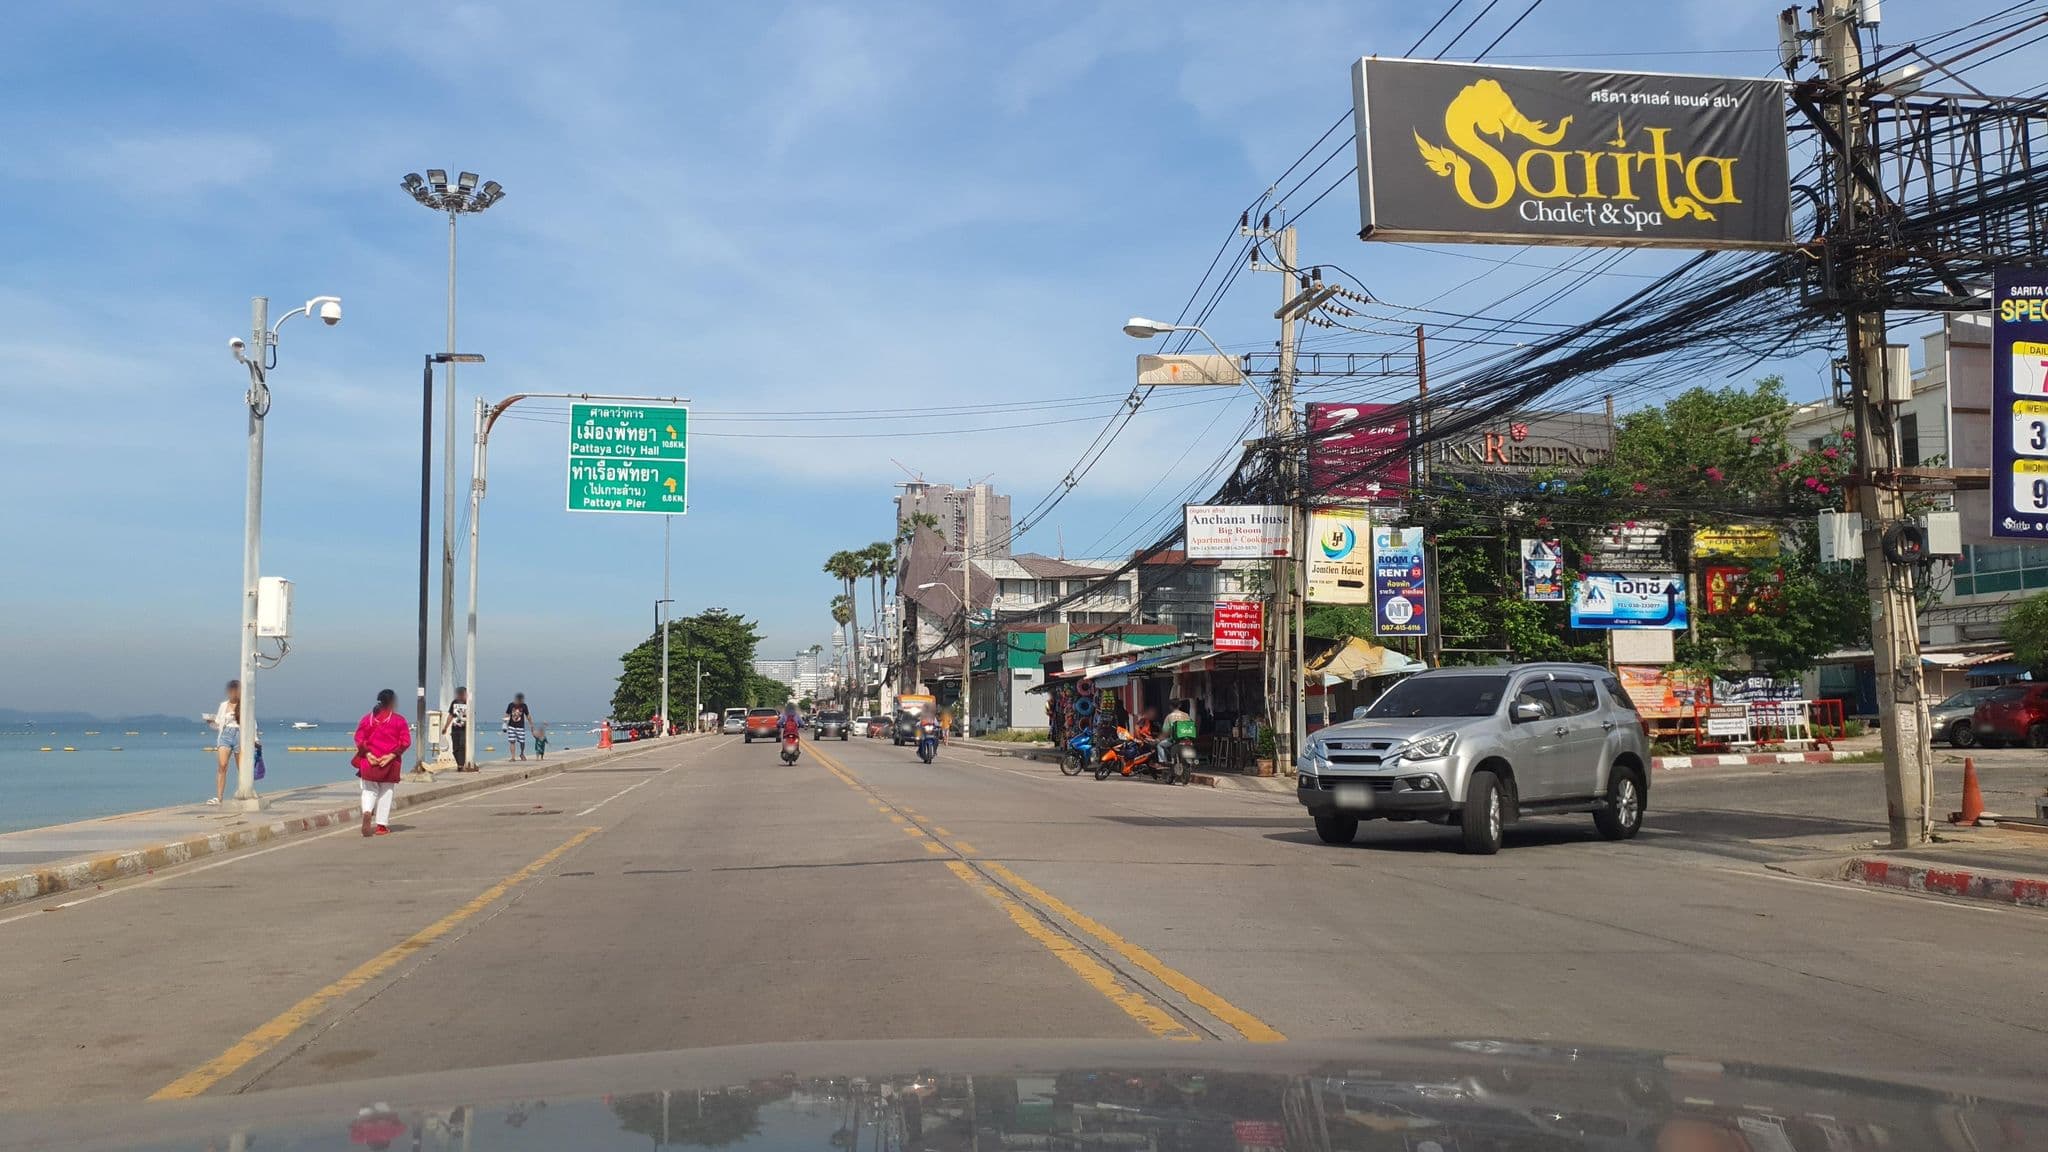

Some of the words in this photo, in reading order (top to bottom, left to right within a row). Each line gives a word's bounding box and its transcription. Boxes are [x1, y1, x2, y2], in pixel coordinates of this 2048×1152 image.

[1591, 89, 1627, 103] ศริตา
[1630, 91, 1670, 105] ชาเลต์
[1674, 93, 1709, 107] แอนด์
[1713, 94, 1739, 108] สปา
[1413, 79, 1742, 221] Sarita
[1520, 200, 1597, 227] Chalet
[1600, 204, 1621, 223] &
[1624, 204, 1663, 231] Spa
[2010, 286, 2043, 296] SARITA
[590, 407, 644, 419] ศาลาว่าการ
[577, 420, 657, 442] เมืองพัทยา
[2031, 420, 2046, 450] 3
[572, 443, 612, 456] Pattaya
[615, 445, 636, 457] City
[640, 445, 660, 456] Hall
[572, 460, 659, 483] ท่าเรือพัทยา
[2033, 479, 2048, 509] 9
[583, 498, 622, 508] Pattaya
[626, 498, 646, 508] Pier
[1191, 514, 1246, 525] Anchana
[1251, 514, 1290, 525] House
[1218, 527, 1233, 535] Big
[1191, 536, 1231, 545] Apartment
[1378, 555, 1408, 564] ROOM
[1311, 564, 1339, 574] Jomtien
[1341, 565, 1365, 576] Hostel
[1378, 569, 1408, 577] RENT
[1615, 576, 1660, 600] เอทูซี
